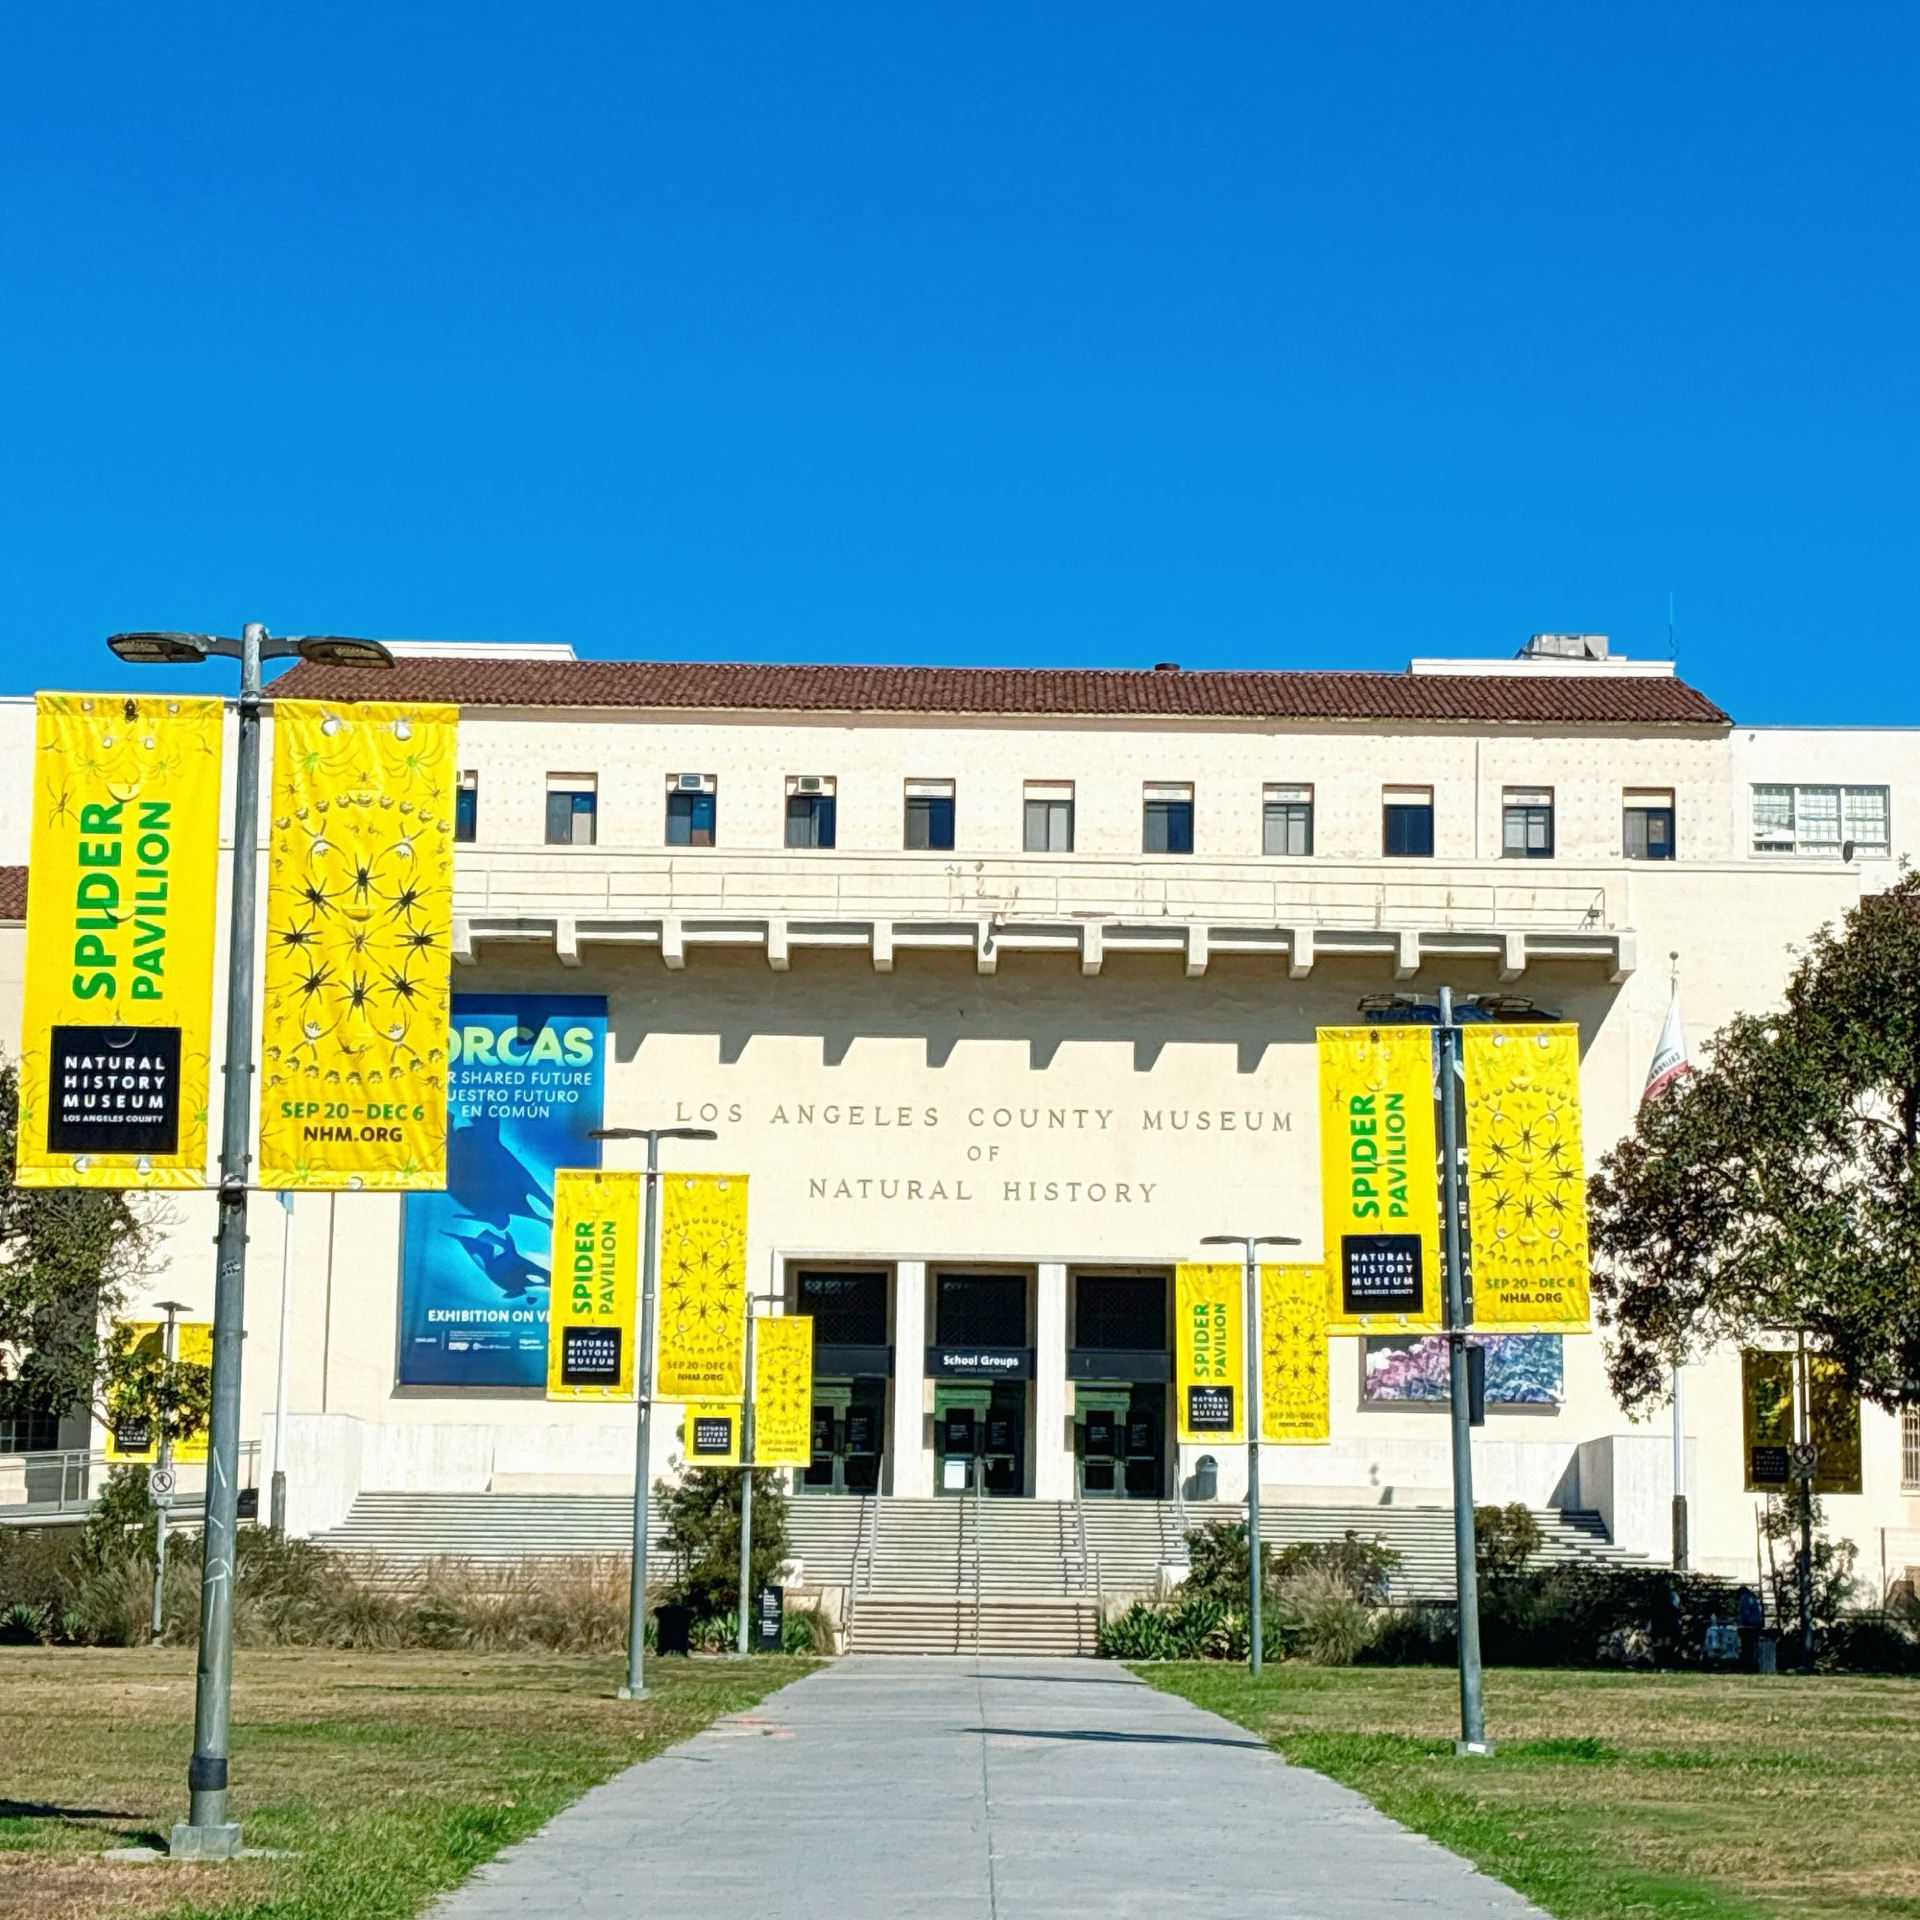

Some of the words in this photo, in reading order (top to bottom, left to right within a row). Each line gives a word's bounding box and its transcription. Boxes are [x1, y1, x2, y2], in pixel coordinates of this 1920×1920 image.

[72, 802, 123, 1000] SPIDER
[131, 802, 171, 1000] PAVILION
[65, 1056, 165, 1070] NATURAL
[64, 1075, 165, 1090] HISTORY
[461, 1071, 525, 1085] SHARED
[531, 1072, 592, 1086] FUTURE
[63, 1094, 164, 1108] MUSEUM
[447, 1089, 508, 1102] UESTRO
[514, 1089, 579, 1103] FUTURO
[281, 1101, 319, 1118] SEP
[412, 1104, 425, 1121] 6
[461, 1104, 482, 1118] EN
[488, 1102, 550, 1118] COMÚN
[675, 1102, 742, 1122] LOS
[770, 1105, 940, 1127] ANGELES
[968, 1108, 1113, 1129] COUNTY
[1142, 1110, 1293, 1132] MUSEUM
[63, 1114, 81, 1122] LOS
[82, 1115, 124, 1123] ANGELES
[125, 1115, 163, 1123] COUNTY
[303, 1126, 403, 1142] NHM.ORG
[967, 1146, 999, 1161] OF
[1350, 1094, 1380, 1218] SPIDER
[1384, 1093, 1408, 1217] PAVILION
[809, 1178, 972, 1200] NATURAL
[1003, 1182, 1157, 1202] HISTORY
[1351, 1252, 1413, 1262] NATURAL
[572, 1221, 595, 1314] SPIDER
[599, 1221, 616, 1314] PAVILION
[1351, 1264, 1413, 1274] HISTORY
[1351, 1276, 1413, 1286] MUSEUM
[1486, 1278, 1510, 1289] SEP
[1500, 1292, 1562, 1303] NHM.ORG
[428, 1309, 509, 1323] EXHIBITION
[512, 1310, 533, 1323] ON
[1194, 1302, 1210, 1378] SPIDER
[1214, 1303, 1226, 1377] PAVILION
[943, 1355, 978, 1366] School
[980, 1355, 1019, 1368] Groups
